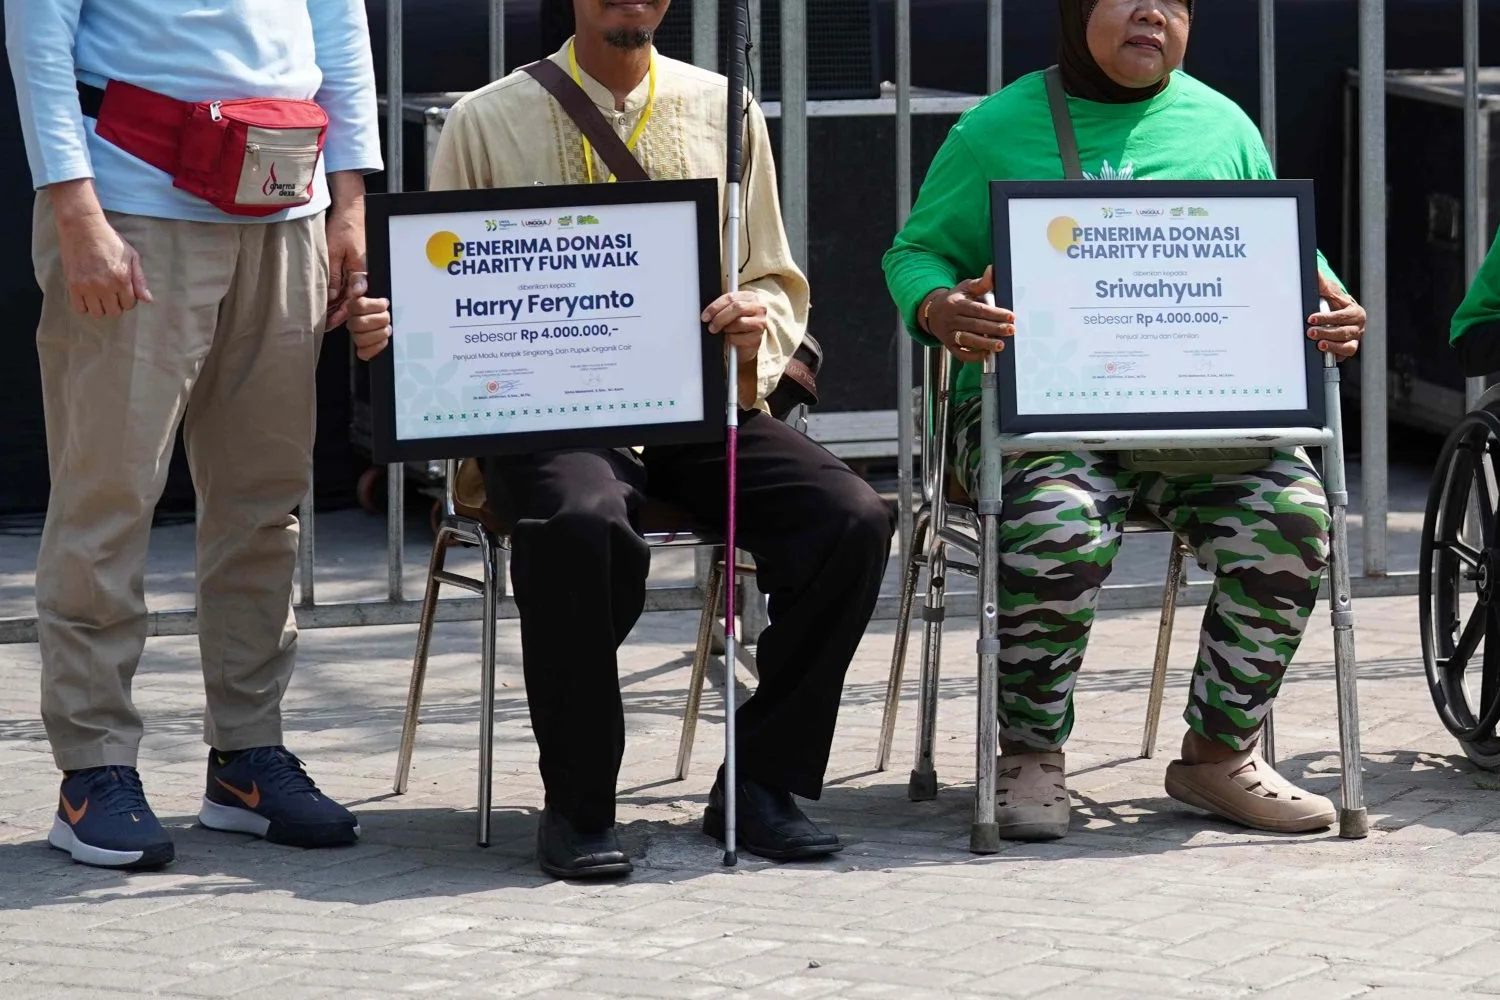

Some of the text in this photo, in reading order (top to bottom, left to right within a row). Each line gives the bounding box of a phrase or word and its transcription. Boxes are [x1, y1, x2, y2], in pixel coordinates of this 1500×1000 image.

[1072, 226, 1240, 242] PENERIMA DONASI
[453, 233, 632, 257] PENERIMA DONASI
[1066, 243, 1247, 259] CHARITY FUN WALK
[447, 250, 639, 276] CHARITY FUN WALK
[518, 282, 549, 291] diberikan
[1095, 277, 1222, 303] Sriwahyuni
[455, 289, 635, 321] Harry Feryanto
[1083, 312, 1229, 327] sebesar Rp 4.000.000,-
[464, 324, 619, 345] sebesar Rp 4.000.000,-
[1116, 333, 1138, 341] Penjual
[1172, 332, 1200, 340] Cemilan
[452, 351, 478, 361] Penjual
[555, 347, 569, 355] Dan
[570, 346, 591, 355] Pupuk
[592, 344, 617, 354] Organik
[618, 343, 632, 351] Cair
